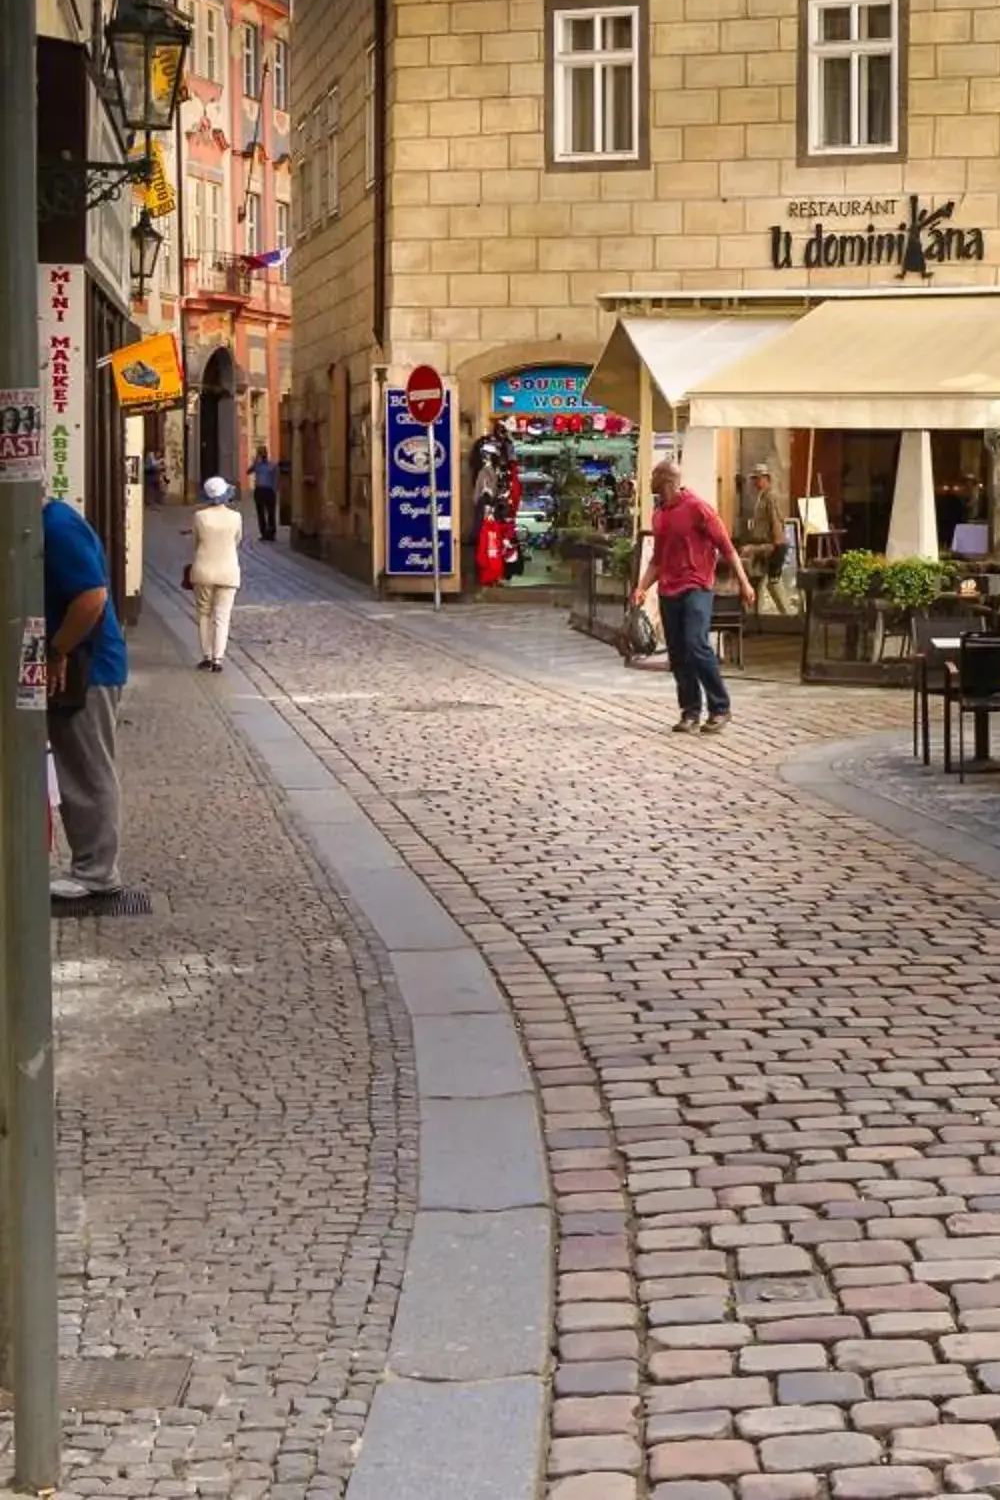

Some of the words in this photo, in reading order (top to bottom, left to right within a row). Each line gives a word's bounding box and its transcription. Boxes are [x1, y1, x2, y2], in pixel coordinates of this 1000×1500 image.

[788, 199, 898, 218] RESTAURANT
[50, 271, 70, 322] MINI
[50, 336, 71, 414] MARKET
